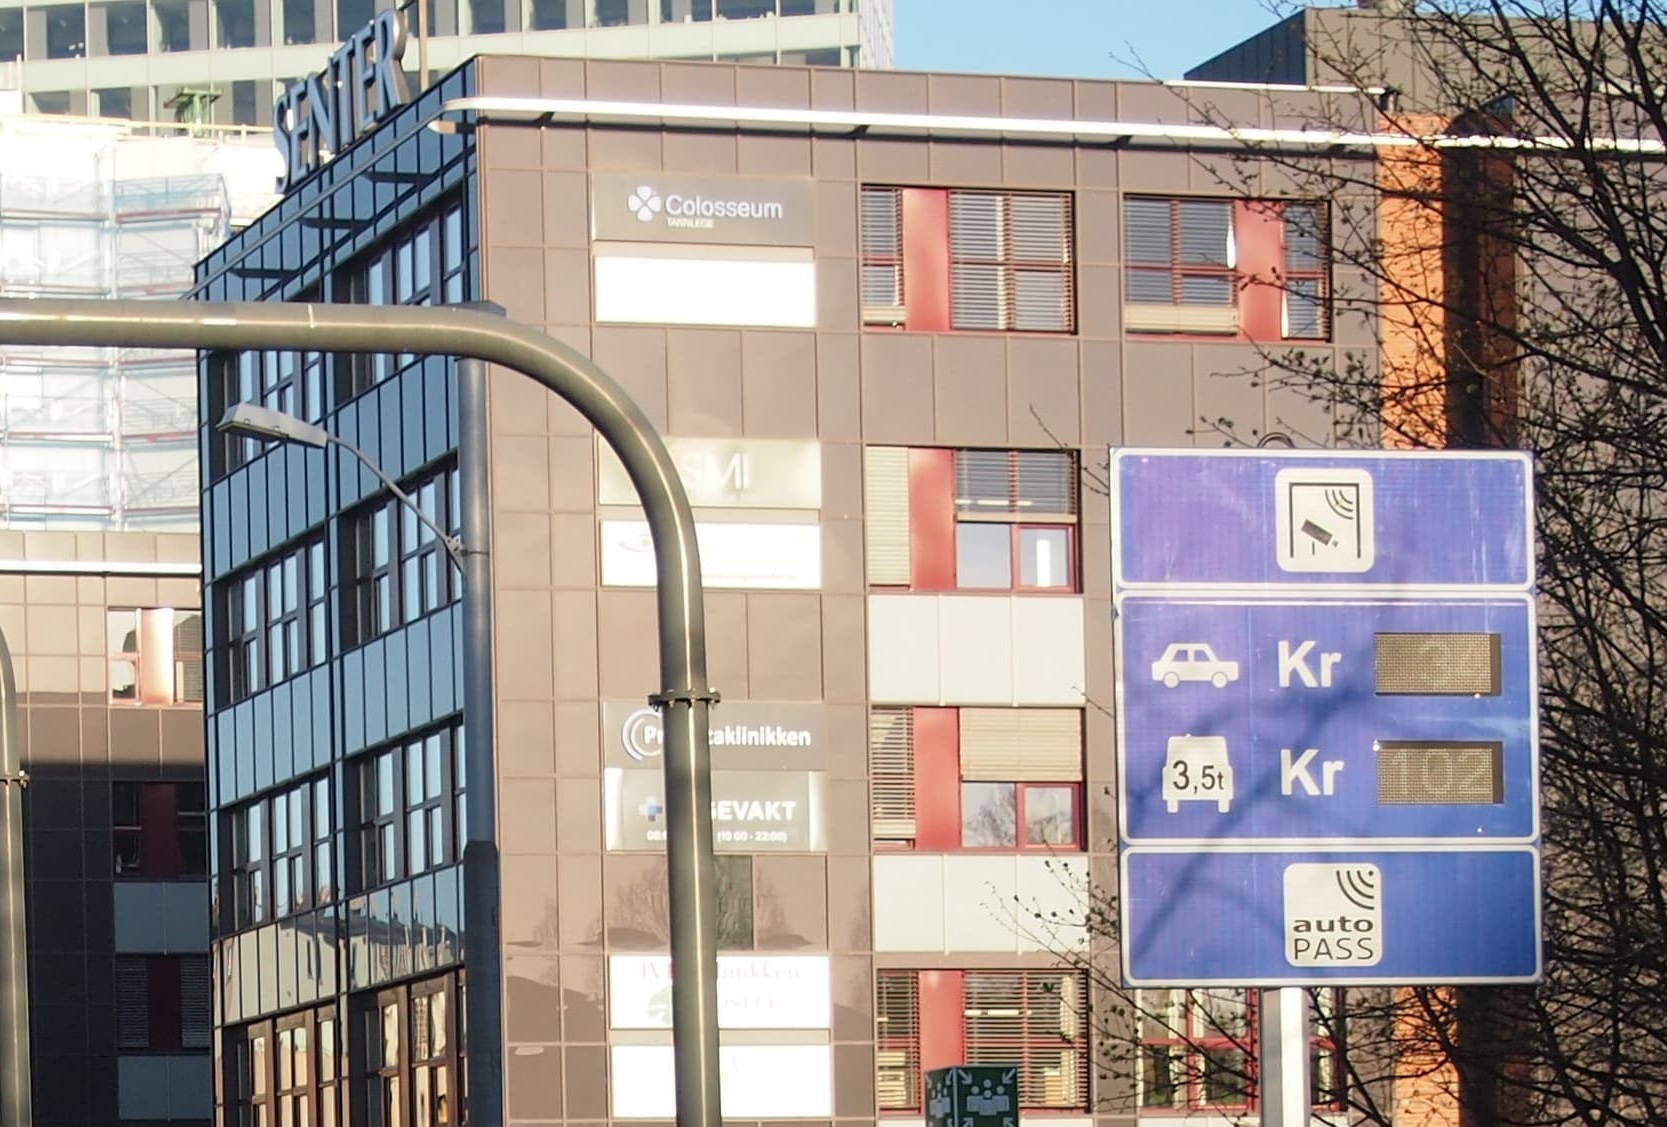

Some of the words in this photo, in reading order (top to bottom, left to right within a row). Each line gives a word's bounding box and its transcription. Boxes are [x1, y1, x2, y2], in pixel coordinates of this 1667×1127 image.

[274, 9, 410, 194] SENTER
[665, 195, 783, 219] Colosseum
[1278, 640, 1342, 688] Kr
[1173, 760, 1224, 795] 3,5t
[1281, 748, 1344, 796] Kr
[1391, 748, 1490, 794] 102
[1293, 916, 1374, 933] auto
[1294, 938, 1374, 960] PASS
